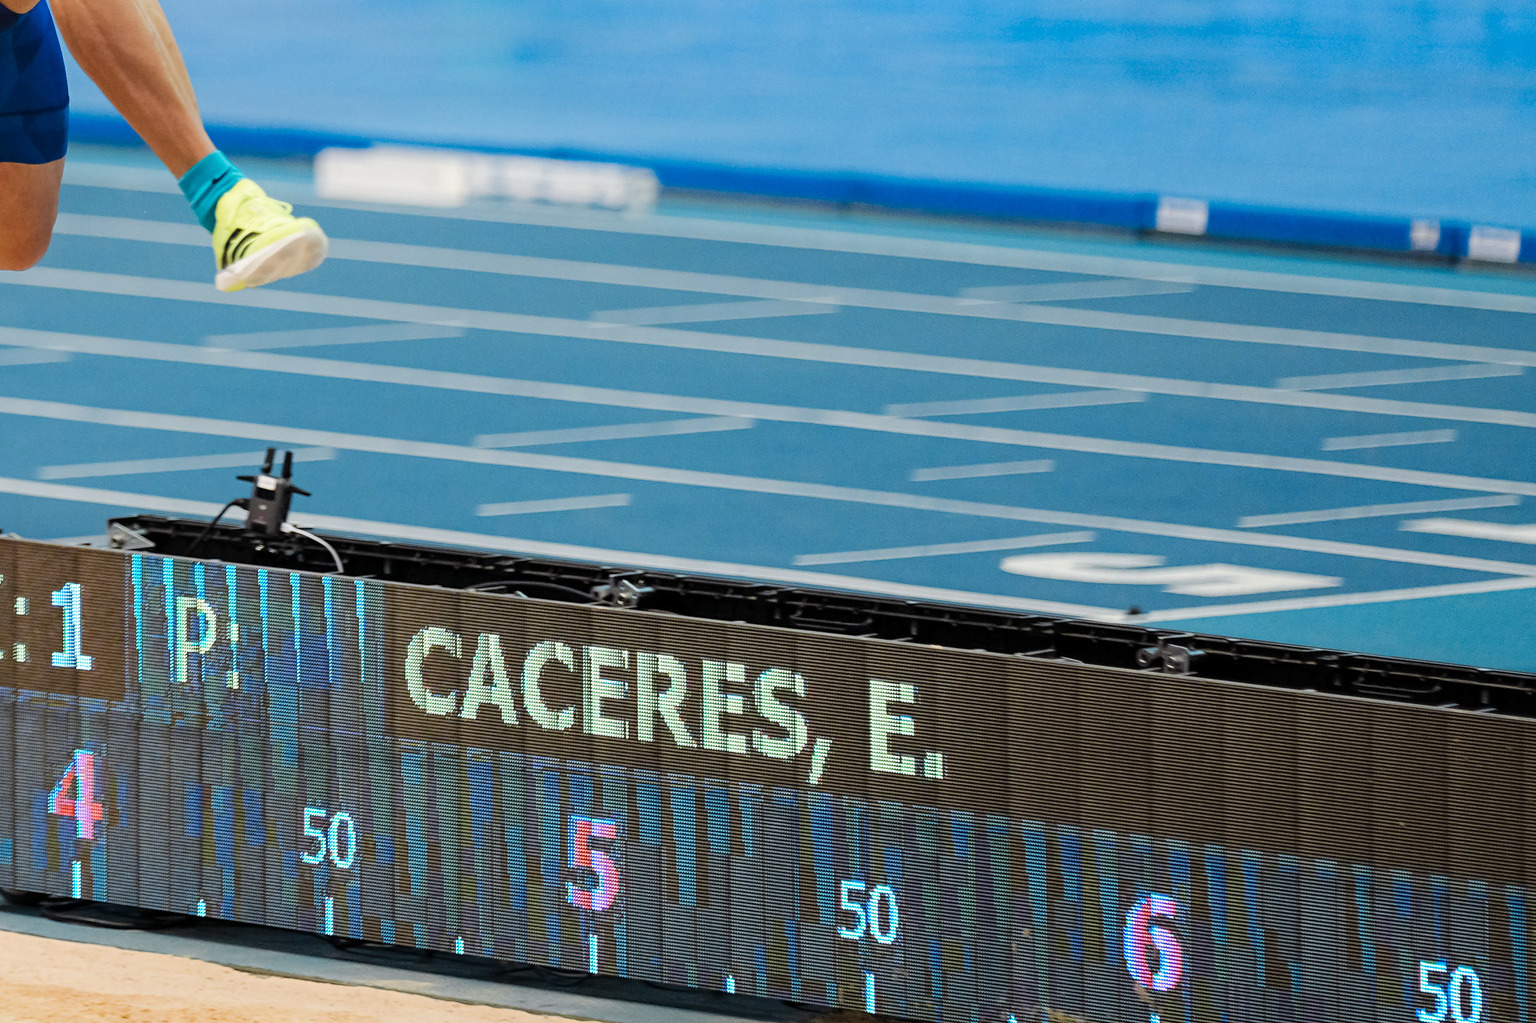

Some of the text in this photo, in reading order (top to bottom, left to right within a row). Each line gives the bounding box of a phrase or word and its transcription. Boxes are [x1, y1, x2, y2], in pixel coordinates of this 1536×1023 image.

[404, 626, 833, 784] CACERES,
[869, 678, 946, 780] E.
[47, 749, 1483, 1023] 4 50 5 50 6 50
